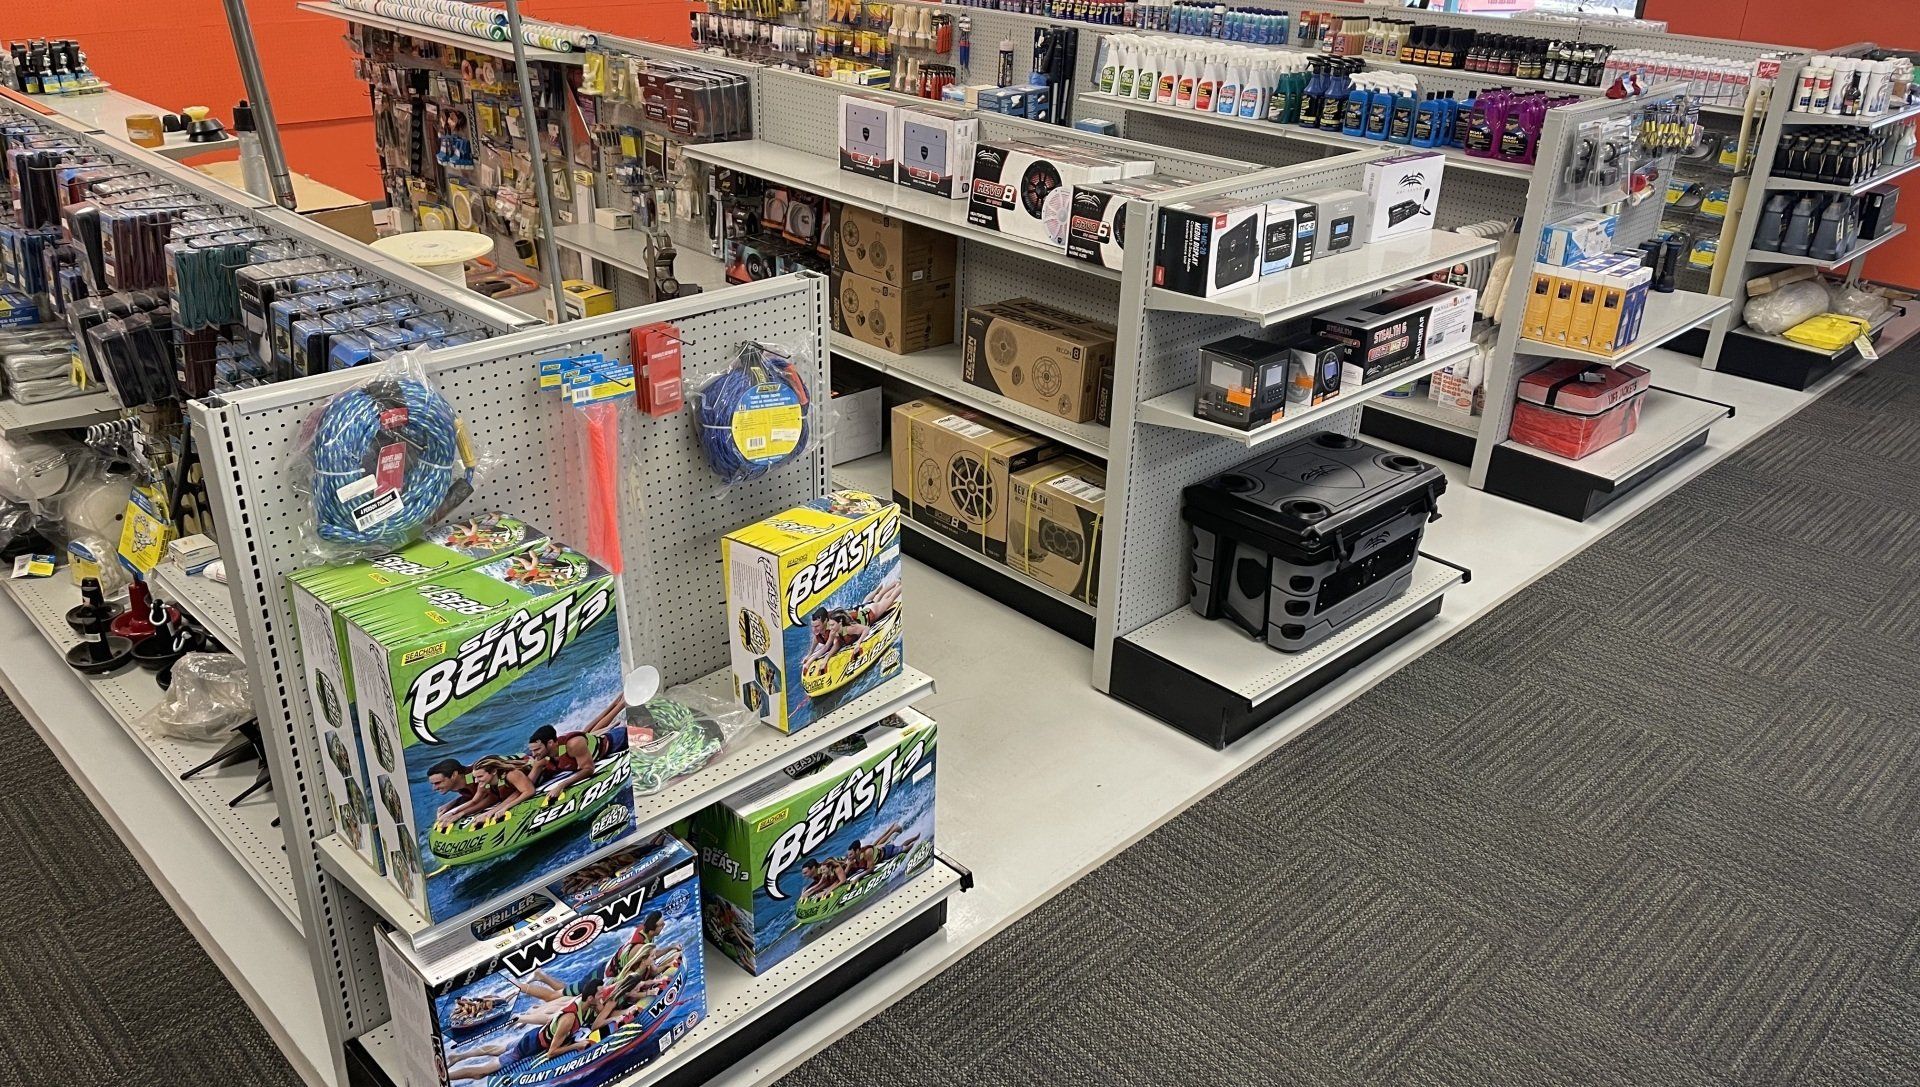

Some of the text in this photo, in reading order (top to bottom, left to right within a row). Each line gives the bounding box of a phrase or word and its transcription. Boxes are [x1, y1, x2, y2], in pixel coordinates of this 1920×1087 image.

[867, 155, 874, 167] 4
[1003, 185, 1015, 202] 8
[1097, 221, 1110, 237] 6
[1191, 222, 1202, 266] MEDIA DISPLAY
[1200, 223, 1209, 255] WS-MC-20
[1373, 324, 1402, 344] STEALTH
[1414, 316, 1425, 360] SOUNDBAR
[966, 336, 977, 381] RECON
[815, 529, 855, 562] SEA
[786, 516, 897, 626] BEAST 2
[404, 643, 445, 661] SEACHOICE
[458, 608, 530, 656] SEA
[406, 589, 610, 743] BEAST 3
[847, 656, 868, 676] SEA
[787, 752, 823, 776] BEAST
[530, 762, 631, 830] SEA BEAS
[807, 766, 864, 817] SEA
[433, 832, 489, 853] SEACHOICE
[591, 808, 628, 837] BEAST
[766, 750, 898, 898] BEAST
[634, 855, 659, 874] THRILLER
[702, 846, 749, 881] BEAST 3
[841, 864, 896, 904] SEA BEAST
[475, 894, 535, 934] THRILLER
[502, 886, 647, 978] WOW
[649, 975, 683, 1019] WOW
[519, 1042, 610, 1086] GIANT THRILLER
